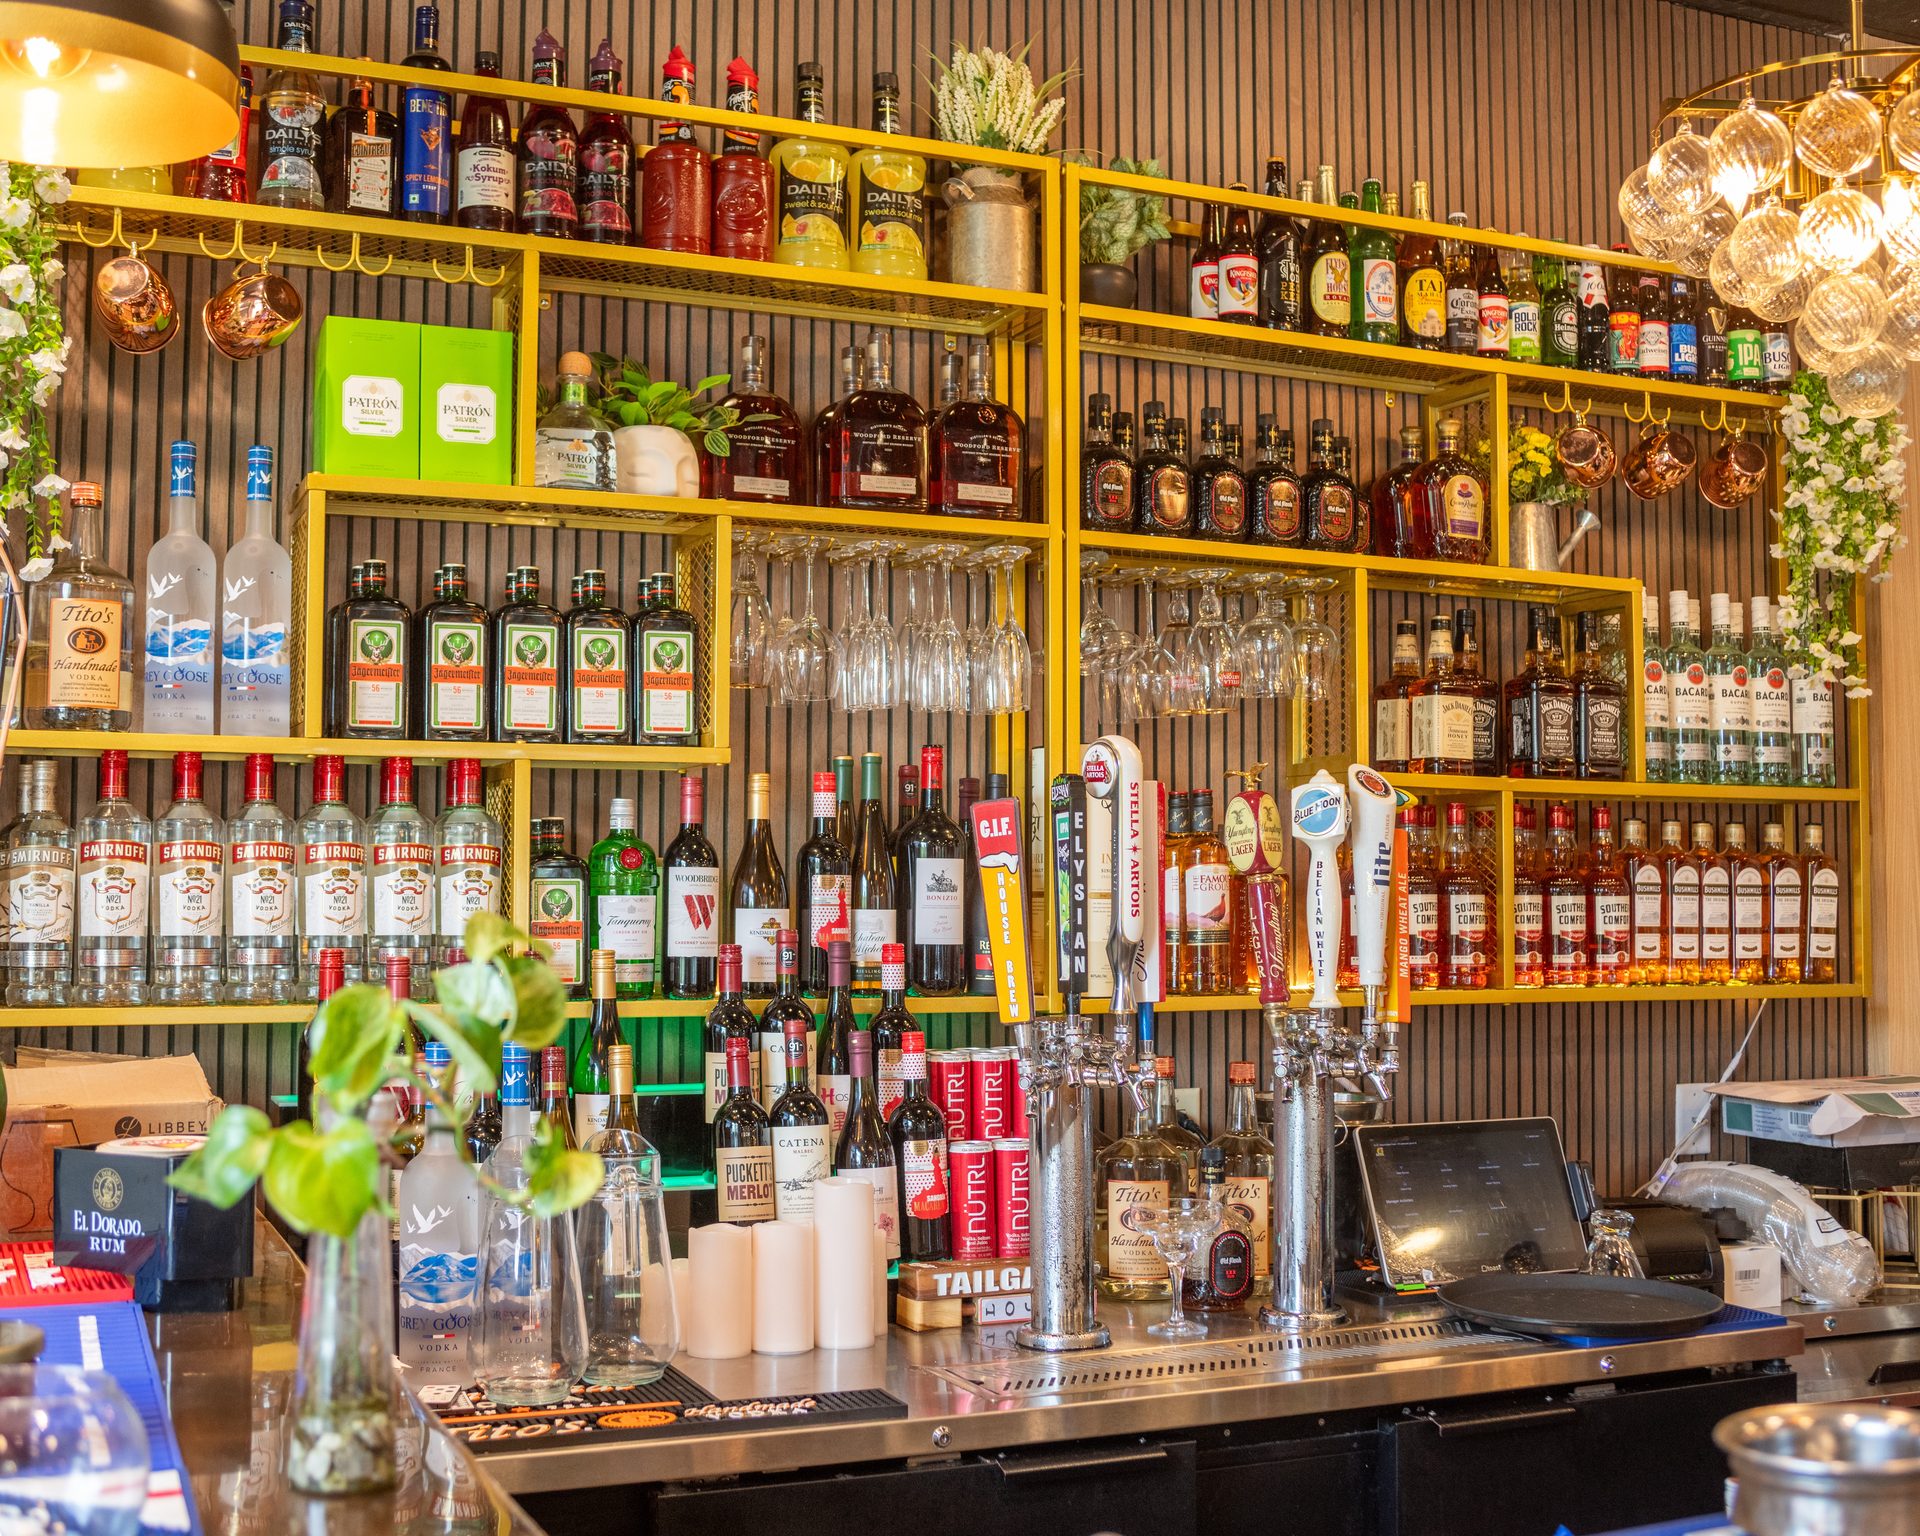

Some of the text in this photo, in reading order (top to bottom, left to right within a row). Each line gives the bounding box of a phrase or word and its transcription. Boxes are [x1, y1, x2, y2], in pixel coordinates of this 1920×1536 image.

[473, 164, 507, 175] Kokum
[474, 173, 505, 185] Syrup
[785, 200, 810, 209] sweet
[866, 192, 923, 210] DAILY'S
[864, 208, 889, 216] sweet
[1416, 278, 1443, 291] TAJ
[1514, 312, 1537, 324] BOLD
[1515, 321, 1538, 332] ROCK
[349, 395, 398, 409] PATRÓN
[360, 408, 385, 416] SILVER
[443, 402, 492, 417] PATRÓN
[455, 416, 478, 424] SILVER
[727, 432, 766, 441] WOODFORD
[765, 436, 797, 445] RESERVE
[893, 433, 922, 442] RESERVE
[953, 441, 1022, 453] WOODFORD RESERVE
[566, 462, 587, 470] SILVER
[53, 657, 118, 673] Handmade
[371, 684, 380, 693] 56
[452, 686, 462, 695] 56
[526, 688, 535, 696] 56
[595, 690, 604, 698] 56
[664, 692, 673, 700] 56
[1085, 763, 1105, 772] STELLA
[1293, 805, 1315, 824] BLUE
[979, 816, 1013, 838] G.I.F.
[1225, 825, 1255, 841] Yuengling
[83, 844, 145, 859] SMIRNOFF
[163, 844, 223, 858] SMIRNOFF
[236, 846, 294, 859] SMIRNOFF
[309, 846, 366, 859] SMIRNOFF
[378, 847, 434, 860] SMIRNOFF
[1129, 781, 1141, 919] STELLA ARTOIS
[1230, 844, 1254, 857] LAGER
[1263, 841, 1282, 853] LAGER
[13, 850, 72, 866] SMIRNOFF
[444, 848, 500, 862] SMIRNOFF
[1373, 841, 1392, 887] lite
[1073, 811, 1086, 974] ELYSIAN
[606, 915, 652, 929] Tanqueray
[1314, 860, 1325, 977] BELGIAN WHITE
[1399, 871, 1409, 978] MANGO WHEAT ALE
[552, 942, 561, 950] 56
[996, 871, 1019, 1018] HOUSE BREW
[1249, 907, 1266, 978] LAGER
[1268, 900, 1284, 979] Yuengling
[148, 1121, 207, 1135] LIBBEY
[778, 1138, 825, 1148] CATENA
[727, 1184, 773, 1201] MERLOT
[74, 1210, 89, 1231] EL
[90, 1236, 126, 1254] RUM
[401, 1315, 427, 1331] GREY
[418, 1343, 459, 1352] VODKA
[419, 1365, 457, 1374] FRANCE
